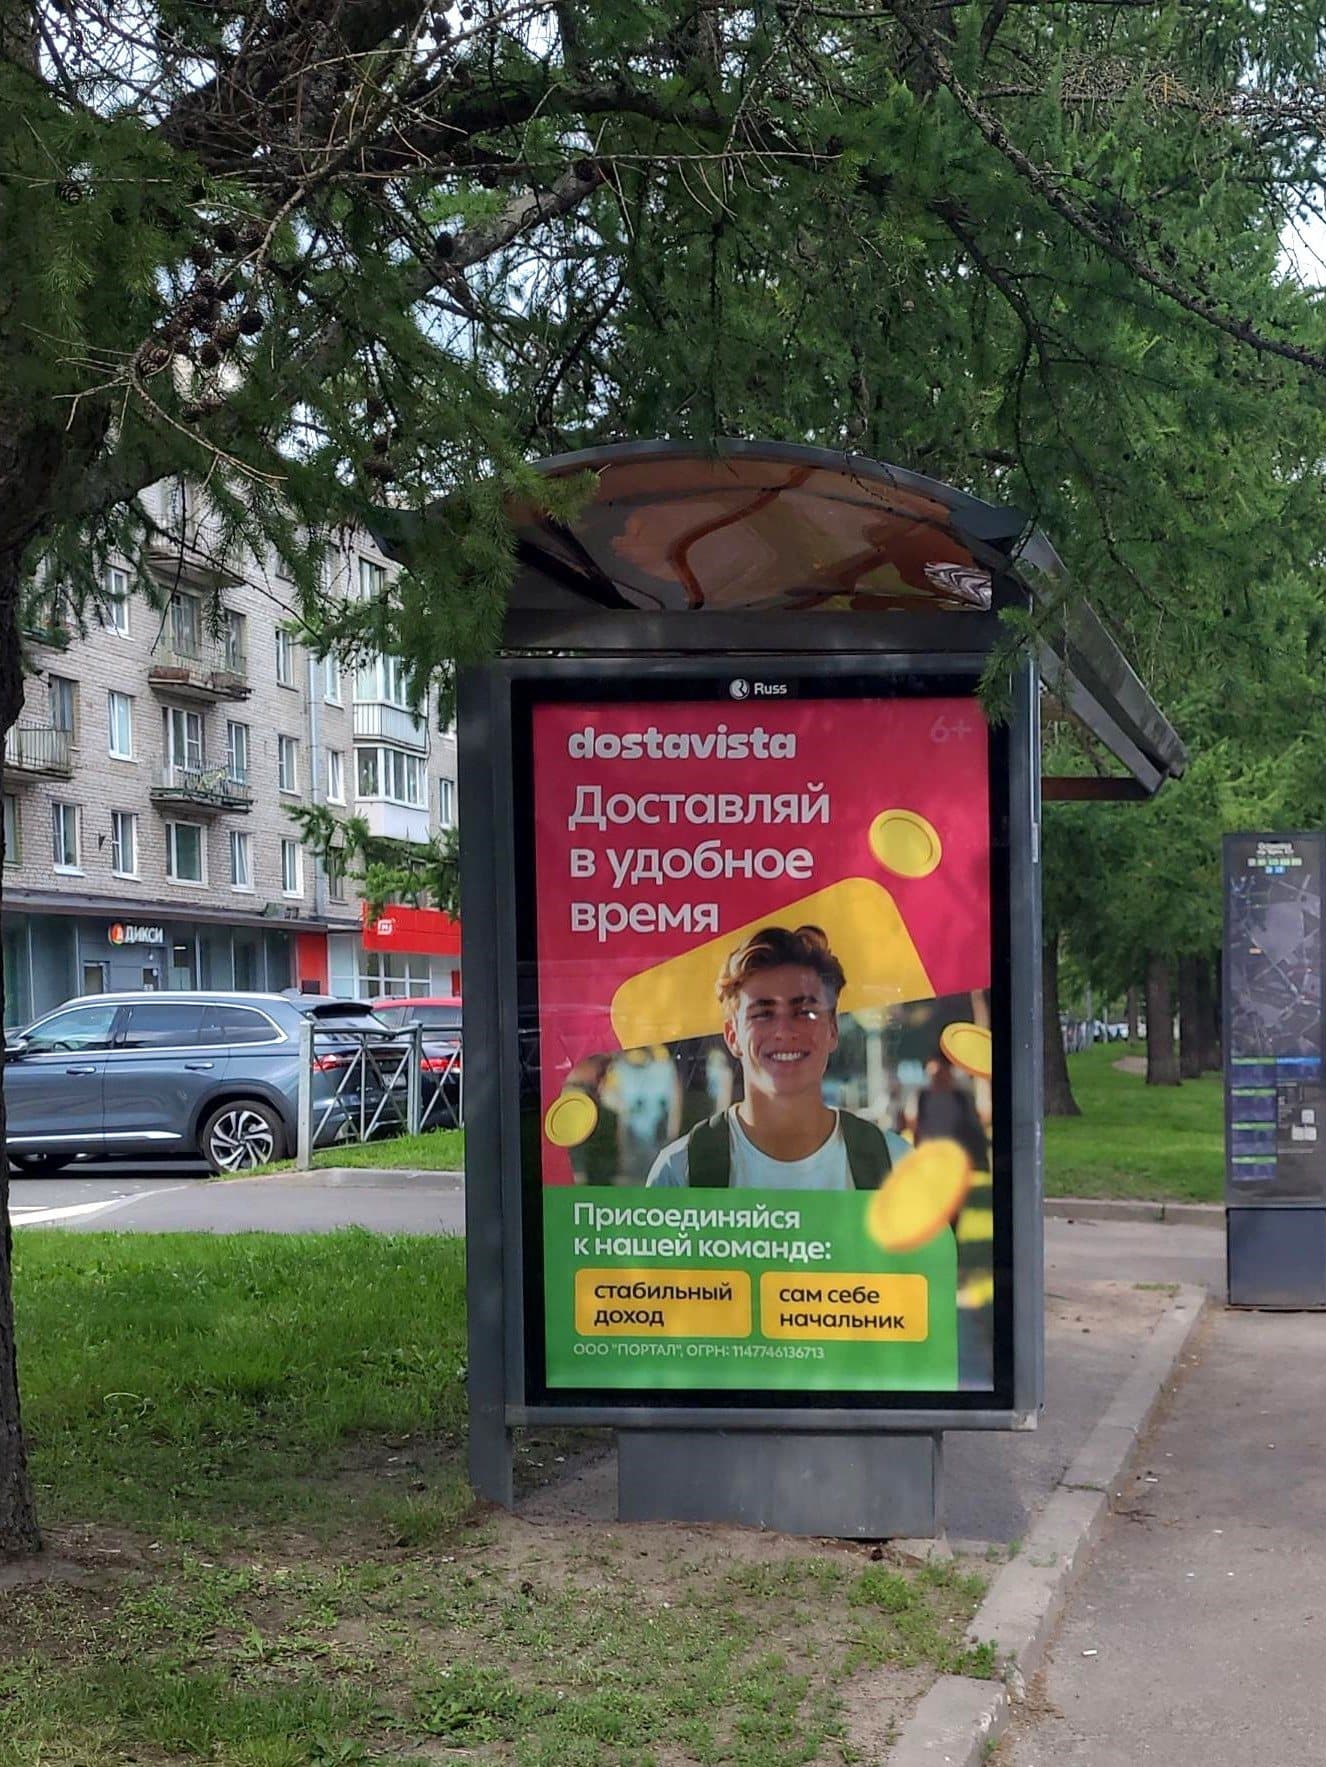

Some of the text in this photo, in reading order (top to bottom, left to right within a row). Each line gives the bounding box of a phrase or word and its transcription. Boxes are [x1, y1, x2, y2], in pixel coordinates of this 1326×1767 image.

[753, 681, 788, 696] Russ
[930, 714, 972, 744] 6+
[567, 724, 797, 760] dostavista
[567, 781, 831, 831] Доставляй
[570, 840, 815, 889] в удобное
[124, 925, 164, 944] ДИКСИ
[570, 901, 721, 943] время
[573, 1201, 801, 1232] Присоединяйся
[573, 1233, 832, 1263] к нашей команде:
[594, 1281, 733, 1302] стабильный
[779, 1285, 881, 1305] сам себе
[594, 1308, 665, 1329] доход
[780, 1312, 905, 1330] начальник
[573, 1343, 609, 1356] ООО
[686, 1344, 729, 1358] ОГРН:
